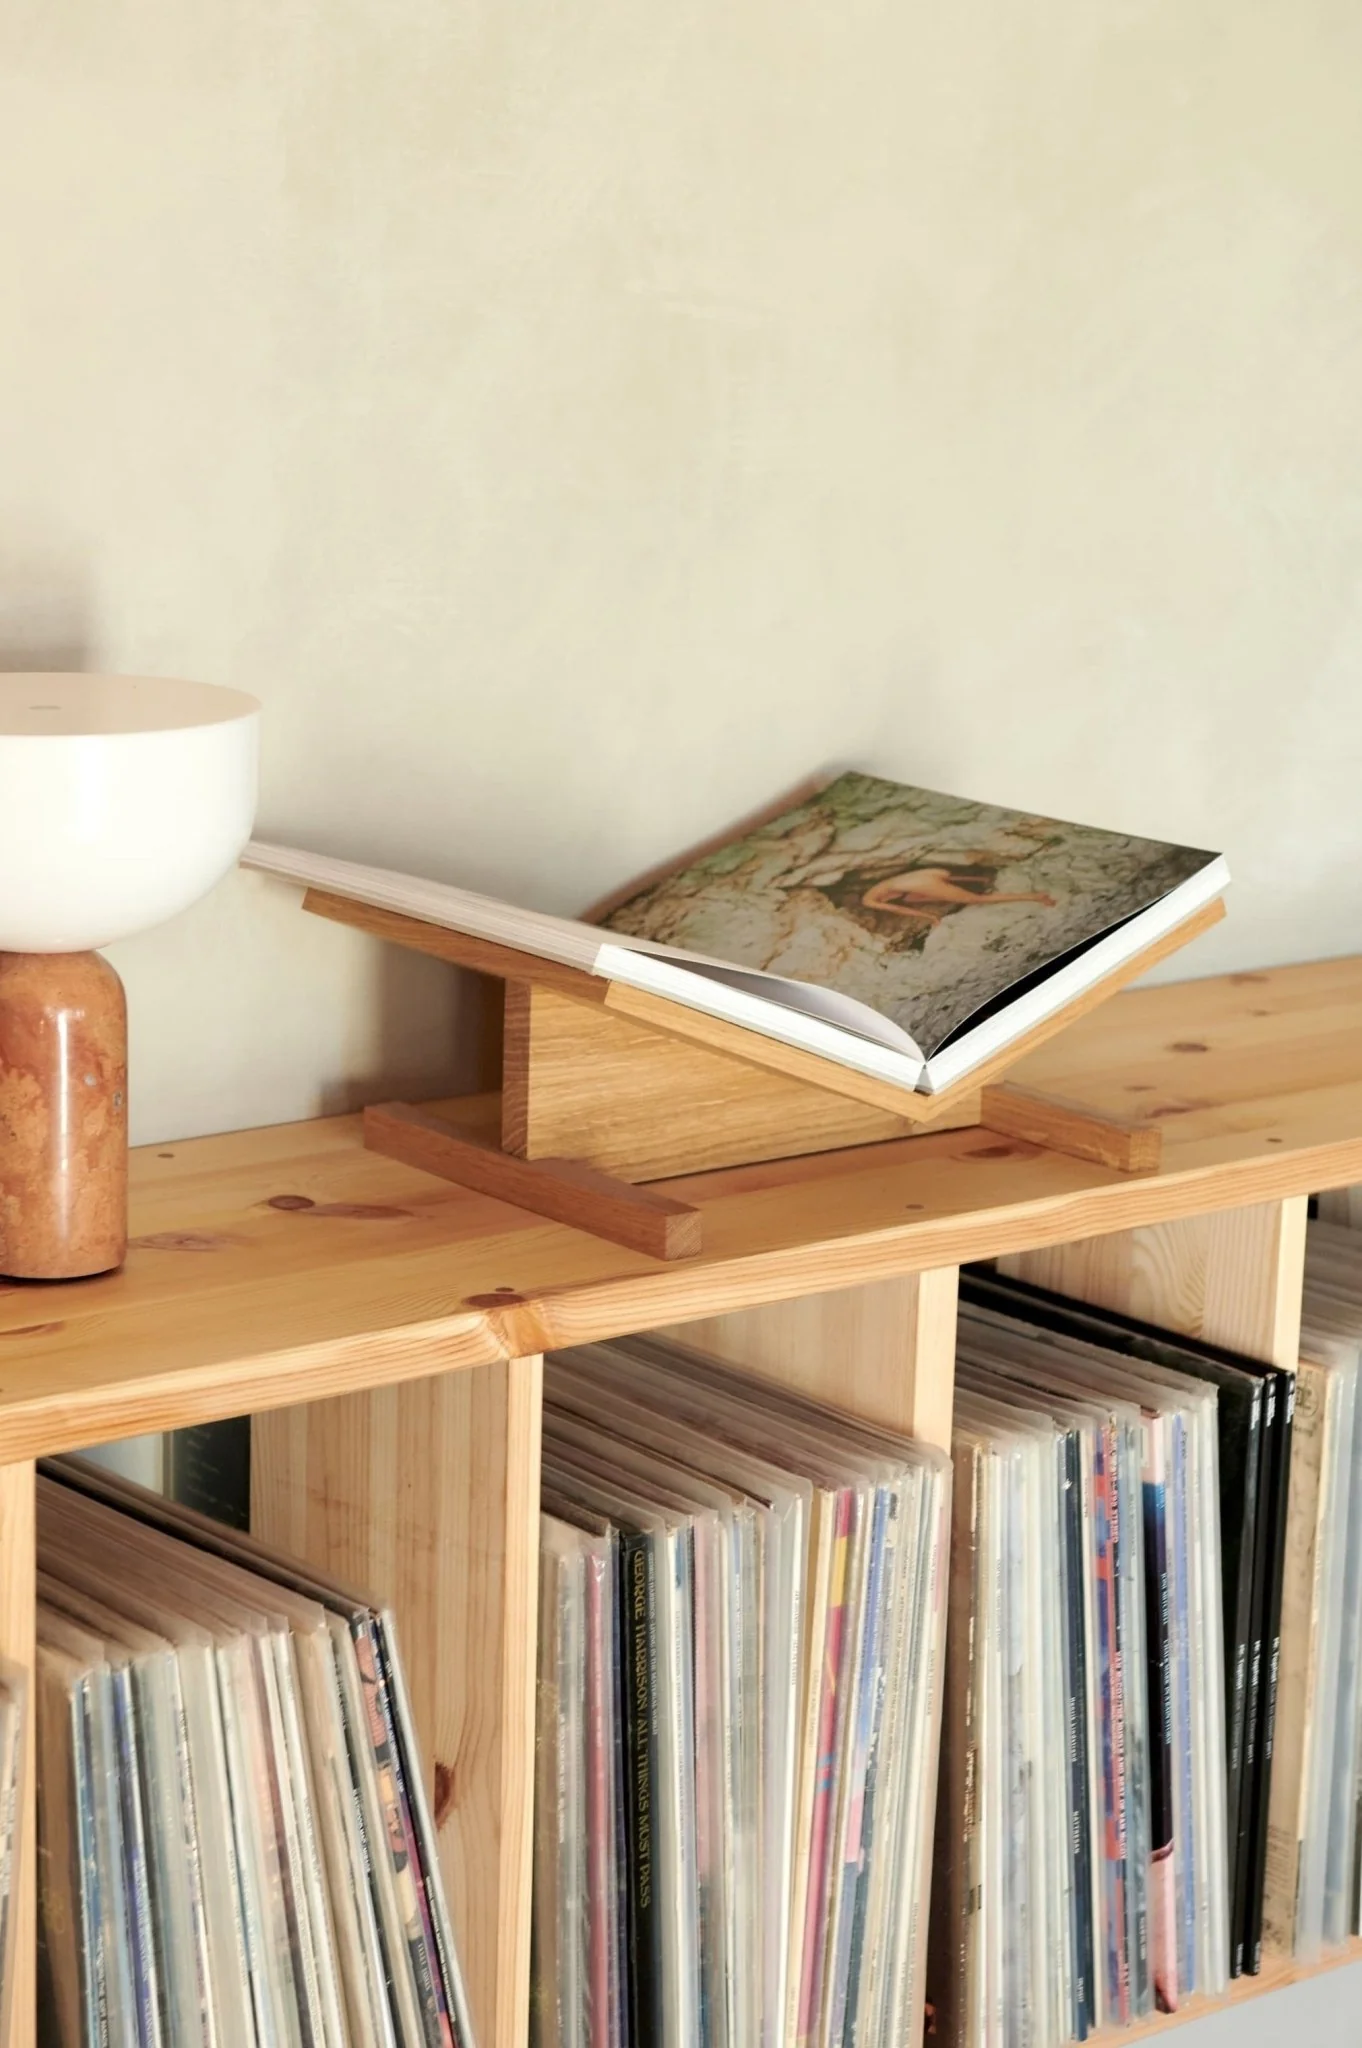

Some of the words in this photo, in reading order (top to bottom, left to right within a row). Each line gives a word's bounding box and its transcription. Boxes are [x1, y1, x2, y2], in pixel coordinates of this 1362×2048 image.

[634, 1550, 646, 1620] GEORGE
[638, 1752, 650, 1812] THINGS
[639, 1814, 650, 1860] MUST
[640, 1862, 651, 1908] PASS
